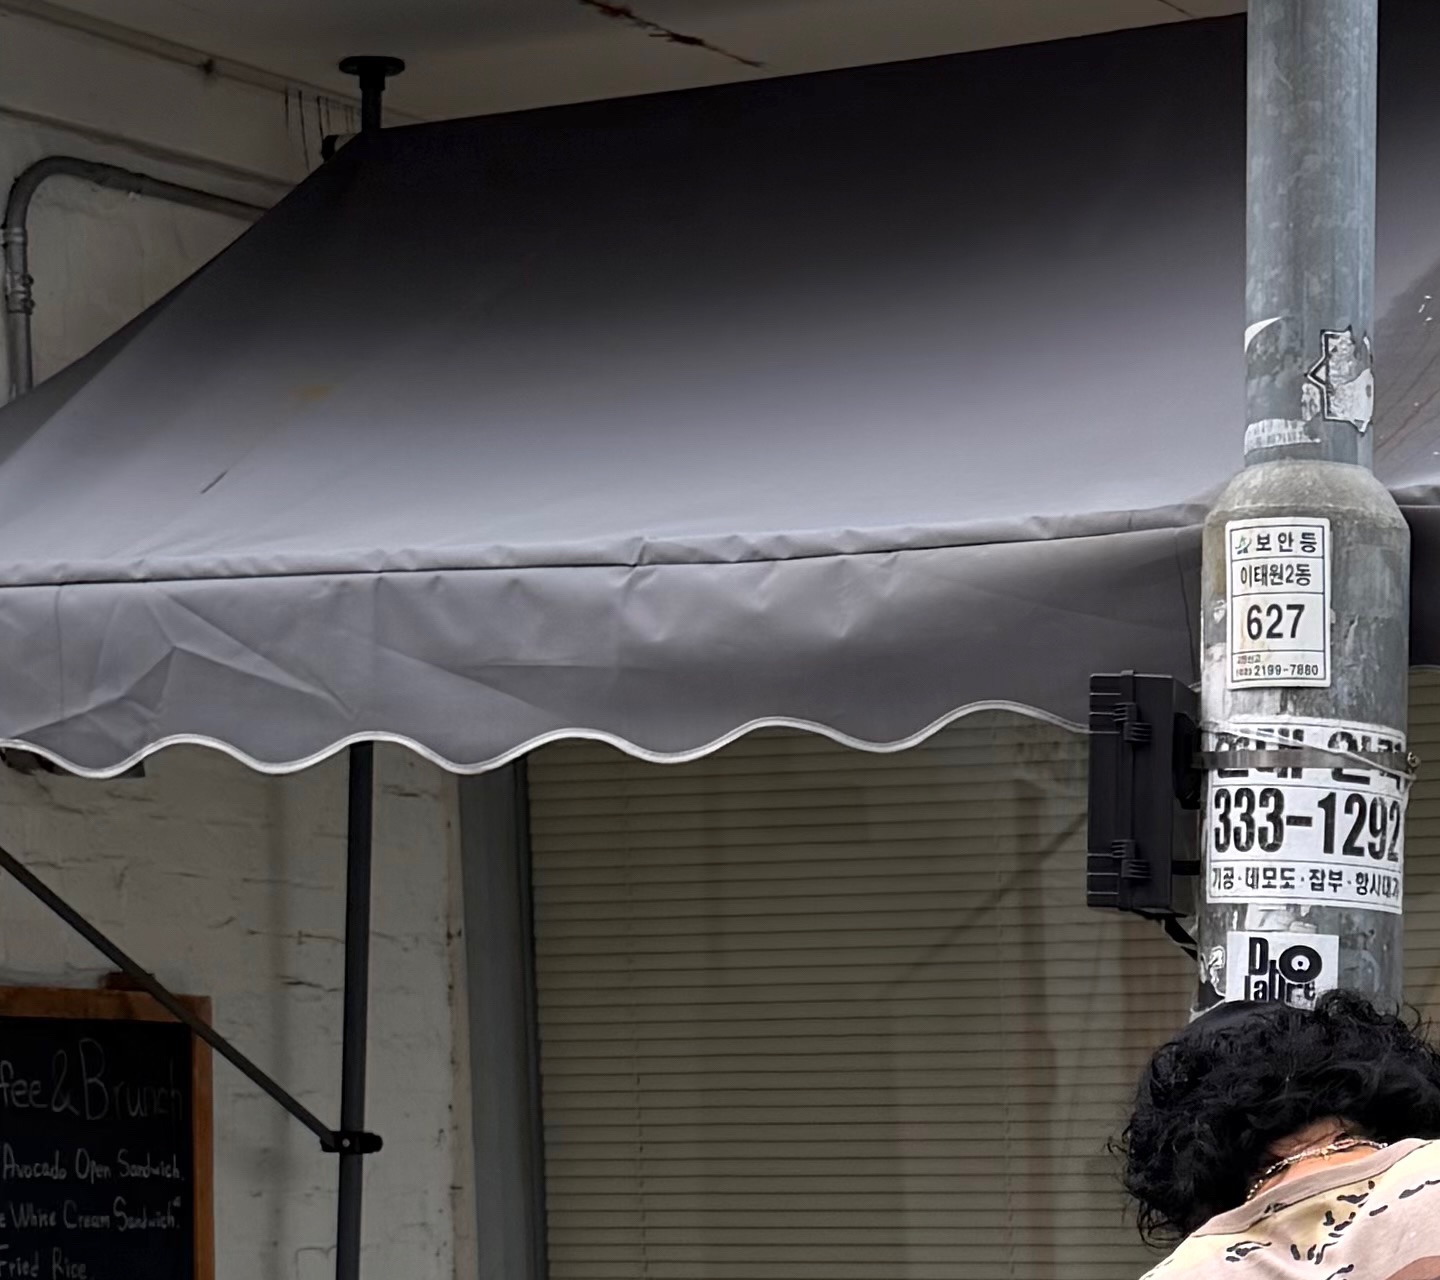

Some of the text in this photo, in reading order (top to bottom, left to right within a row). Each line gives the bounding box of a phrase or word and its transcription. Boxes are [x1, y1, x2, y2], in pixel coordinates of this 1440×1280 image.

[1240, 563, 1311, 587] 이태원2동
[1246, 603, 1305, 640] 627
[1214, 786, 1400, 862] 333-1292
[2, 1142, 68, 1180] Avocado
[75, 1148, 112, 1184] Open
